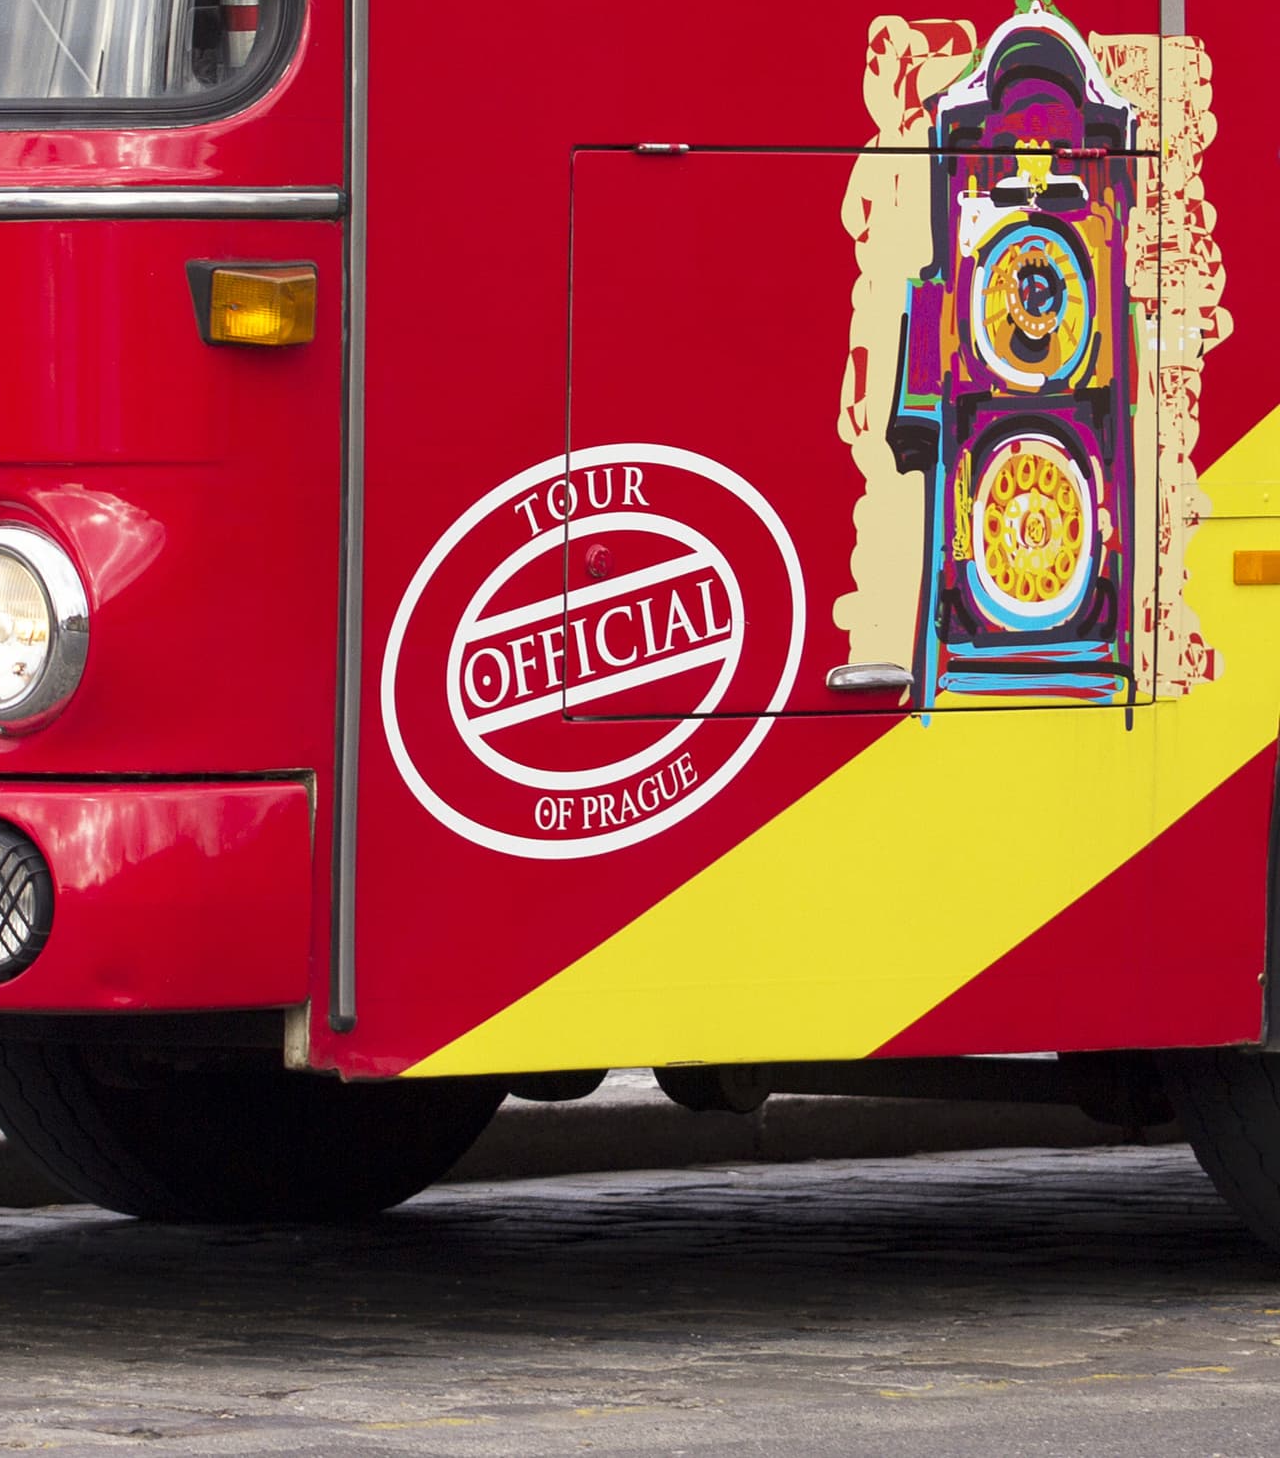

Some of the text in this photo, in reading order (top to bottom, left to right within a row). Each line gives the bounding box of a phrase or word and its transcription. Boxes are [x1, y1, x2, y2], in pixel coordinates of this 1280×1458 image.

[514, 465, 650, 538] TOUR
[464, 577, 732, 710] OFFICIAL
[534, 751, 699, 831] OF PRAGUE
